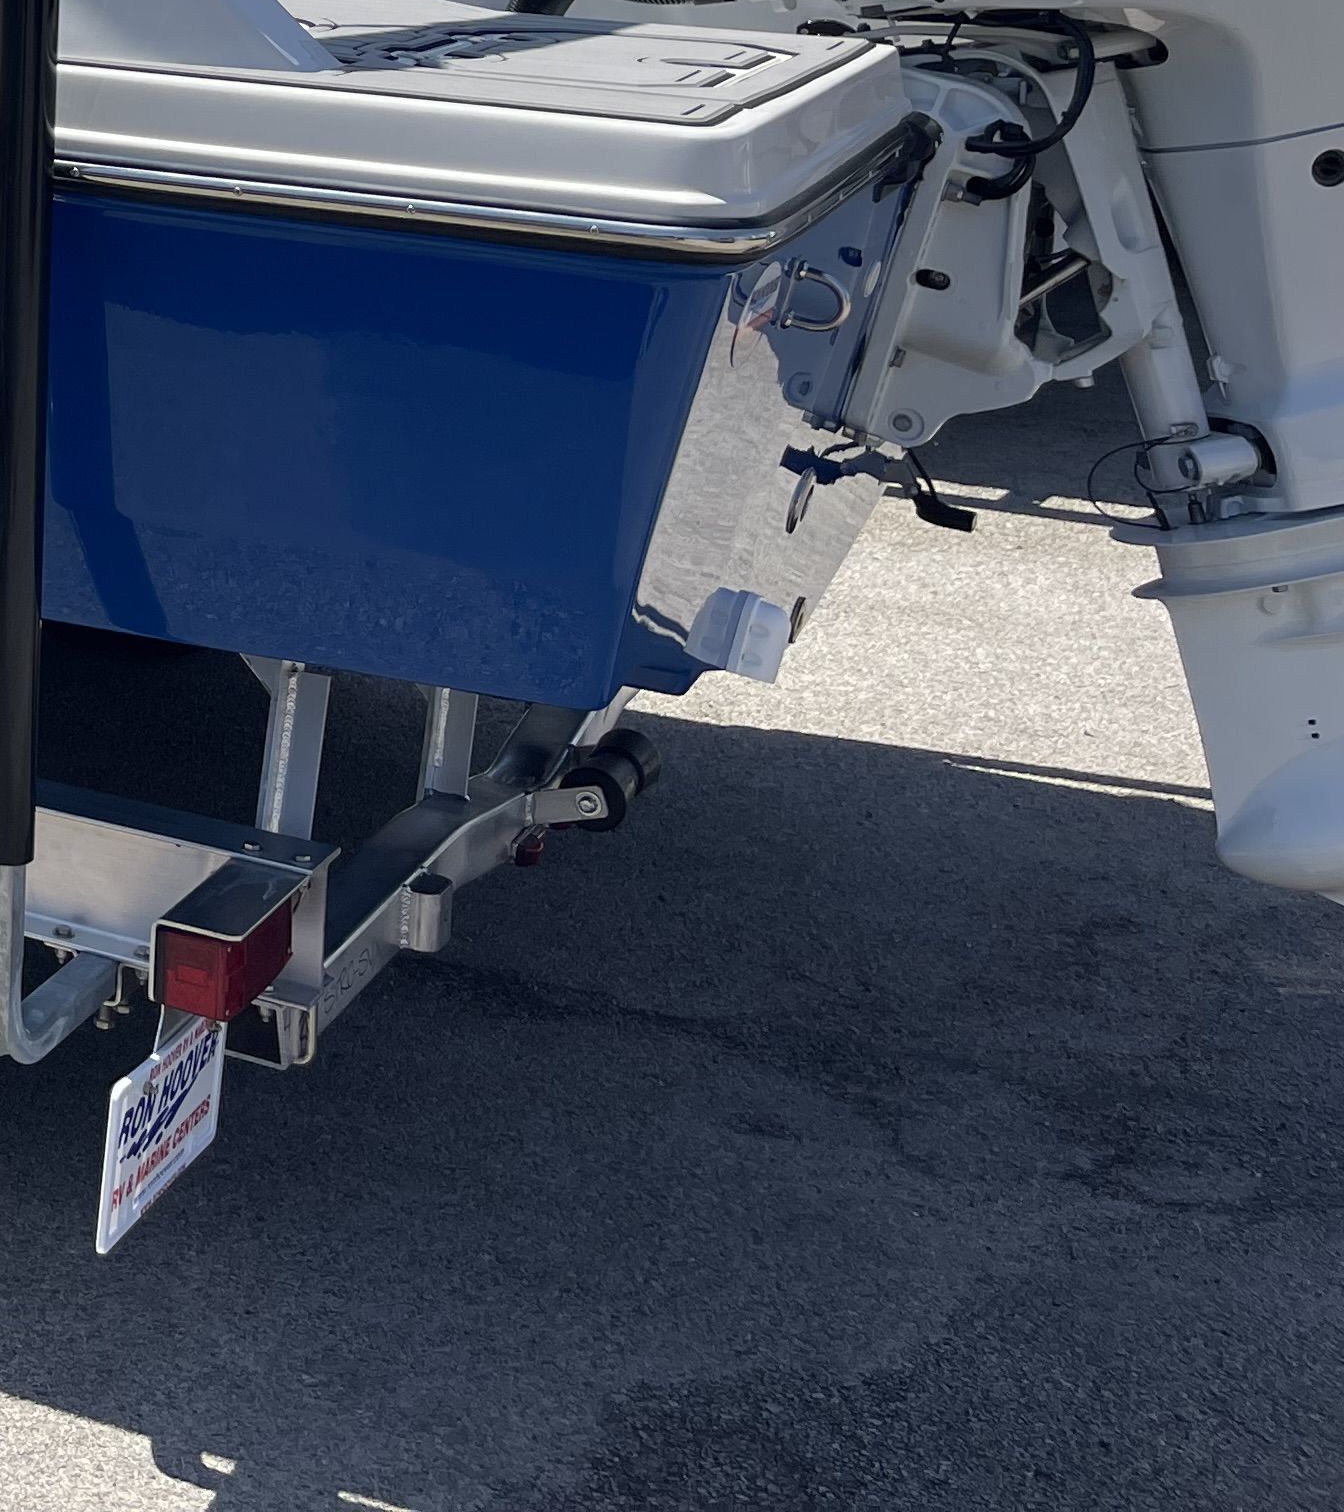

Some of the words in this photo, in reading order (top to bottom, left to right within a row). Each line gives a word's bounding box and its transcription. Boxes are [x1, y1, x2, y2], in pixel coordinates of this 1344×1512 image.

[118, 1084, 159, 1149] RON
[158, 1031, 219, 1114] HOOVER
[111, 1181, 126, 1212] RV
[134, 1135, 172, 1189] MARINE
[173, 1094, 211, 1149] CENTERS
